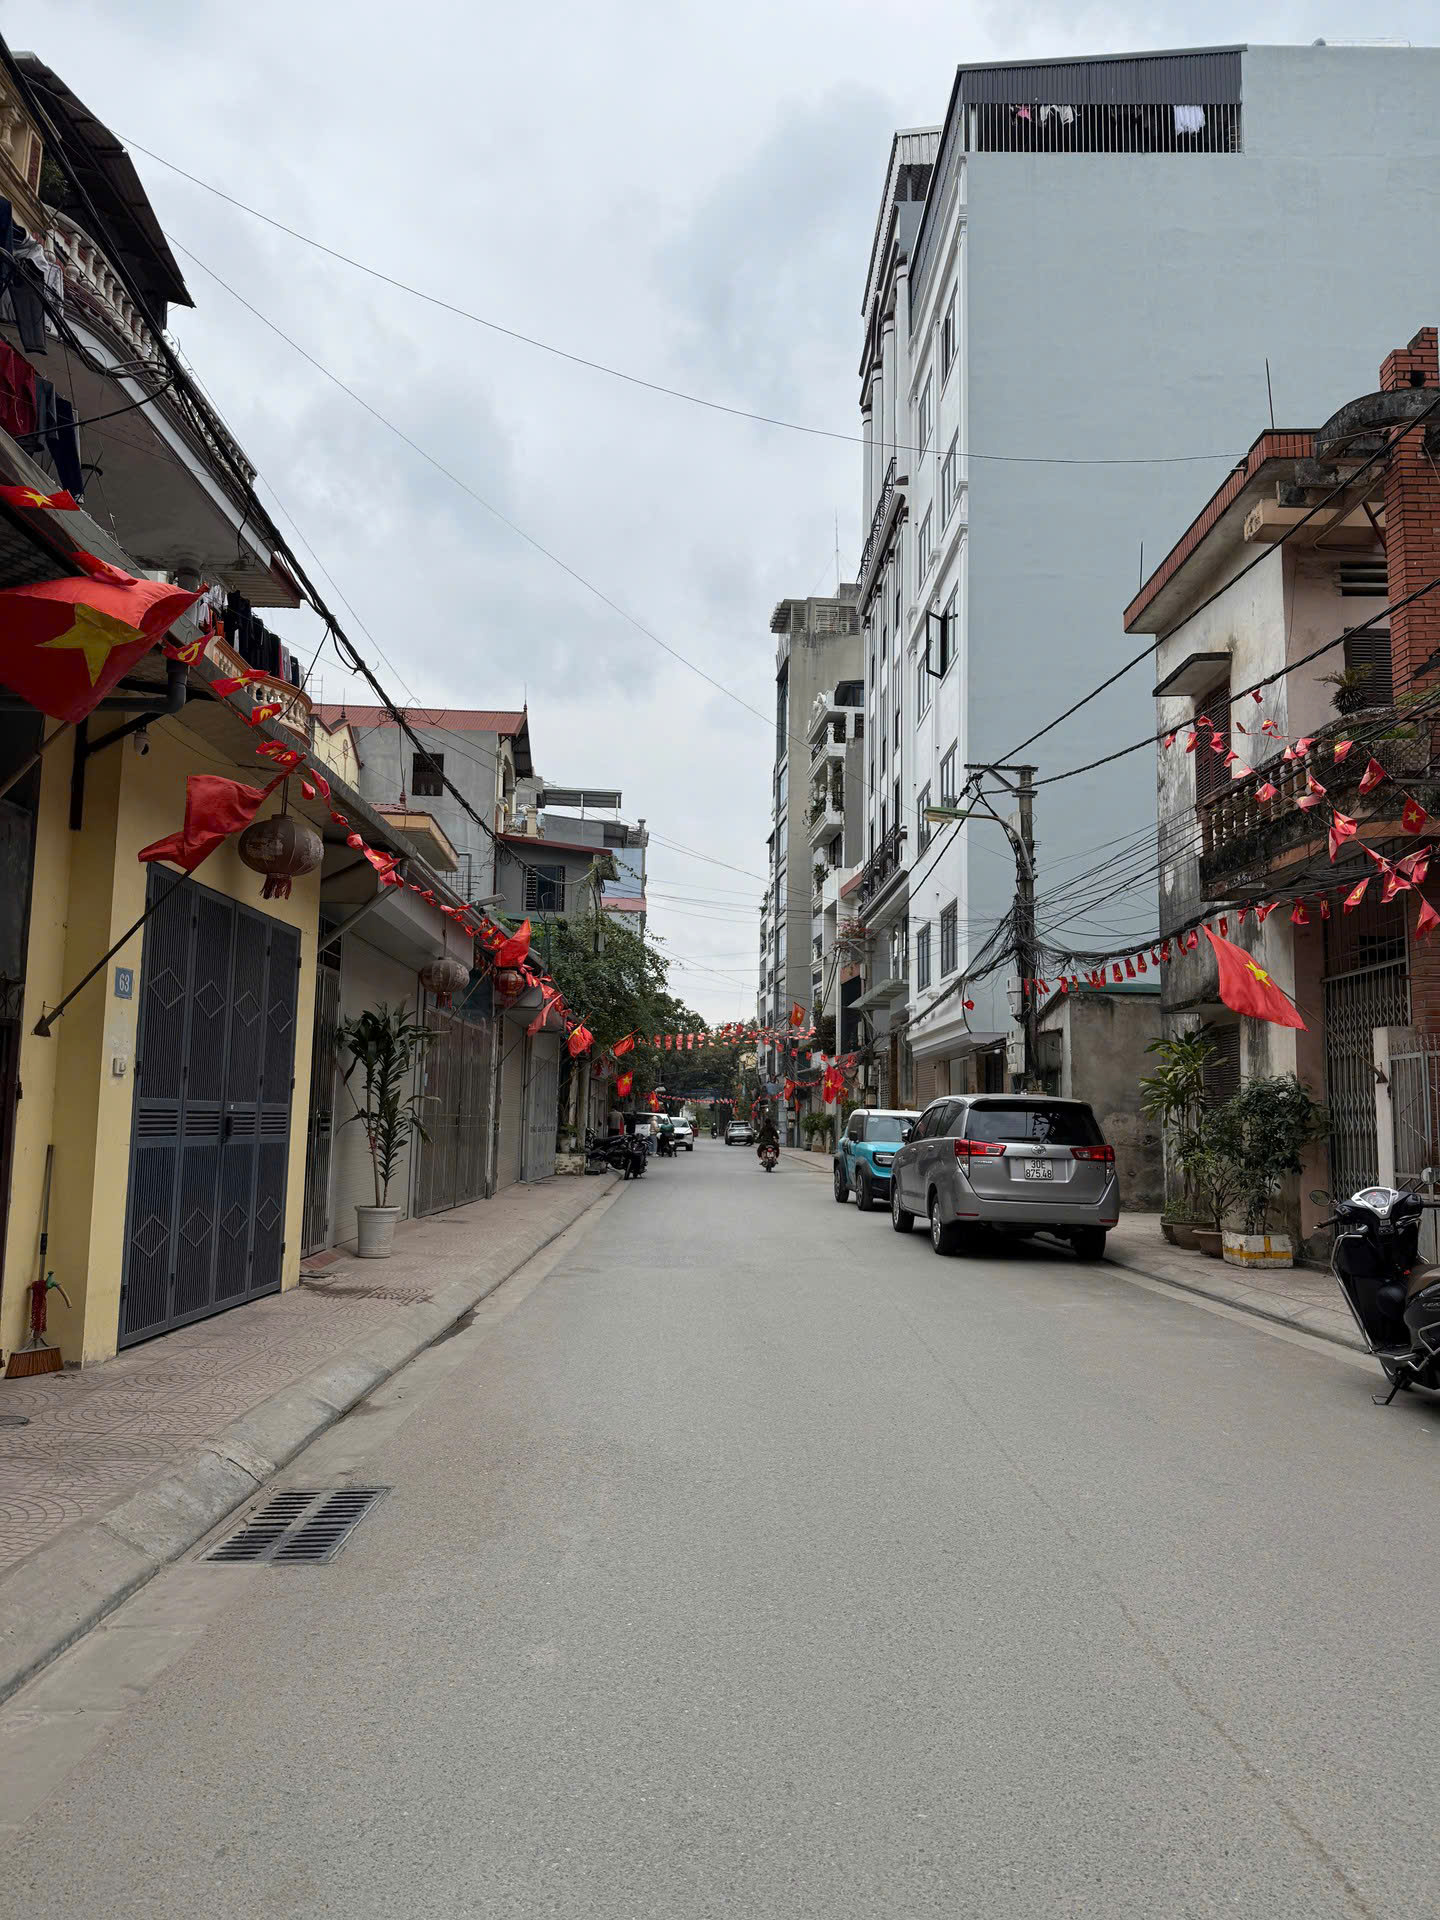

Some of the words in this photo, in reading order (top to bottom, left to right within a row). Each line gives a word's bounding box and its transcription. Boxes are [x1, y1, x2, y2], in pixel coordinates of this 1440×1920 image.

[119, 973, 130, 992] 63
[1031, 1159, 1046, 1169] 30E
[1025, 1169, 1052, 1179] 875.48
